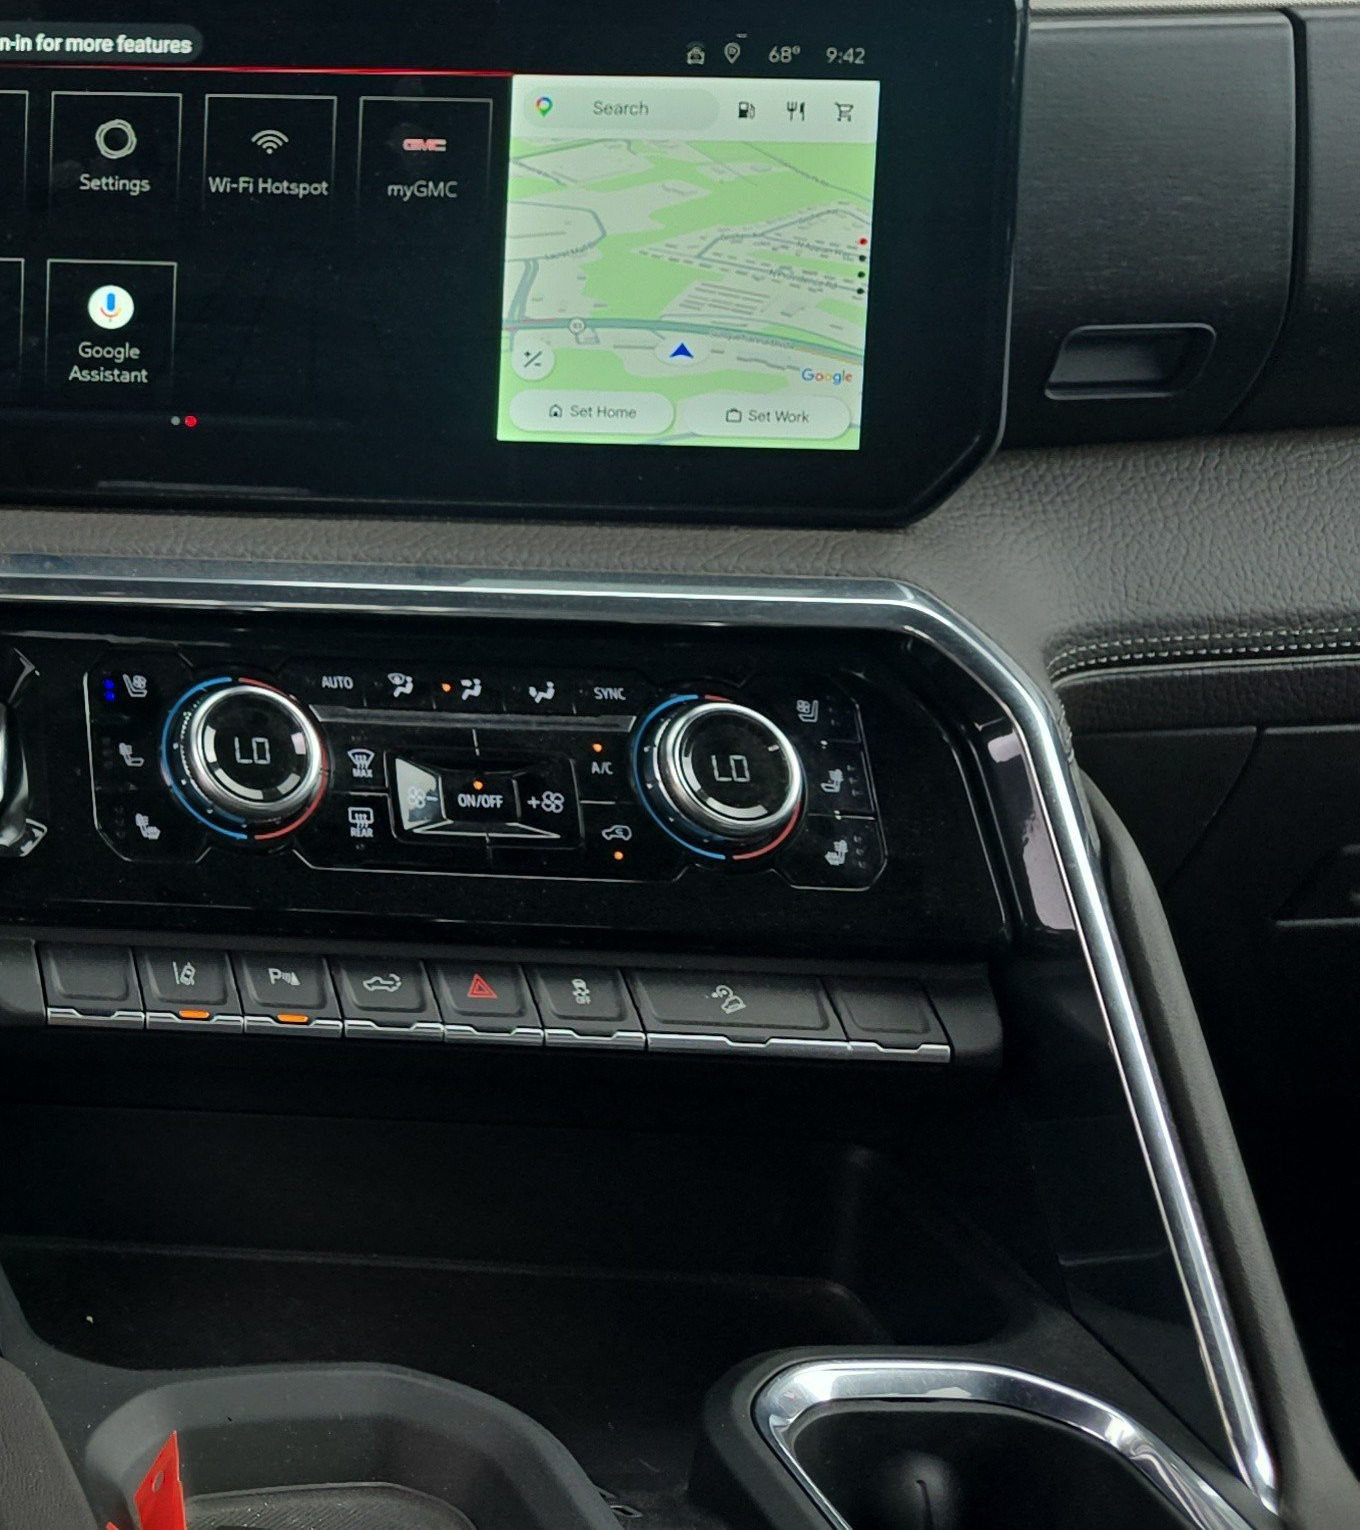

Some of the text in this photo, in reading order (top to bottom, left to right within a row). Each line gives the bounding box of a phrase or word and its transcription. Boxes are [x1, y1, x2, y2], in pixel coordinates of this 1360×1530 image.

[35, 33, 63, 52] for
[65, 38, 114, 53] more
[116, 34, 194, 55] features
[825, 48, 866, 66] 9:42
[592, 100, 650, 118] Search
[79, 173, 152, 196] Settings
[208, 176, 330, 199] Wi-Fi Hotspot
[387, 180, 459, 202] myGMC
[78, 341, 141, 363] Google
[68, 365, 149, 384] Assistant
[801, 368, 853, 386] Google
[569, 403, 637, 420] Set Home
[748, 407, 810, 424] Set Work
[321, 676, 354, 690] AUTO
[593, 687, 627, 701] SYNC
[234, 737, 271, 766] LO
[353, 767, 373, 778] MAX
[591, 761, 613, 775] A/C
[711, 754, 751, 783] LO
[457, 794, 504, 809] ON/OFF
[350, 827, 373, 838] REAR
